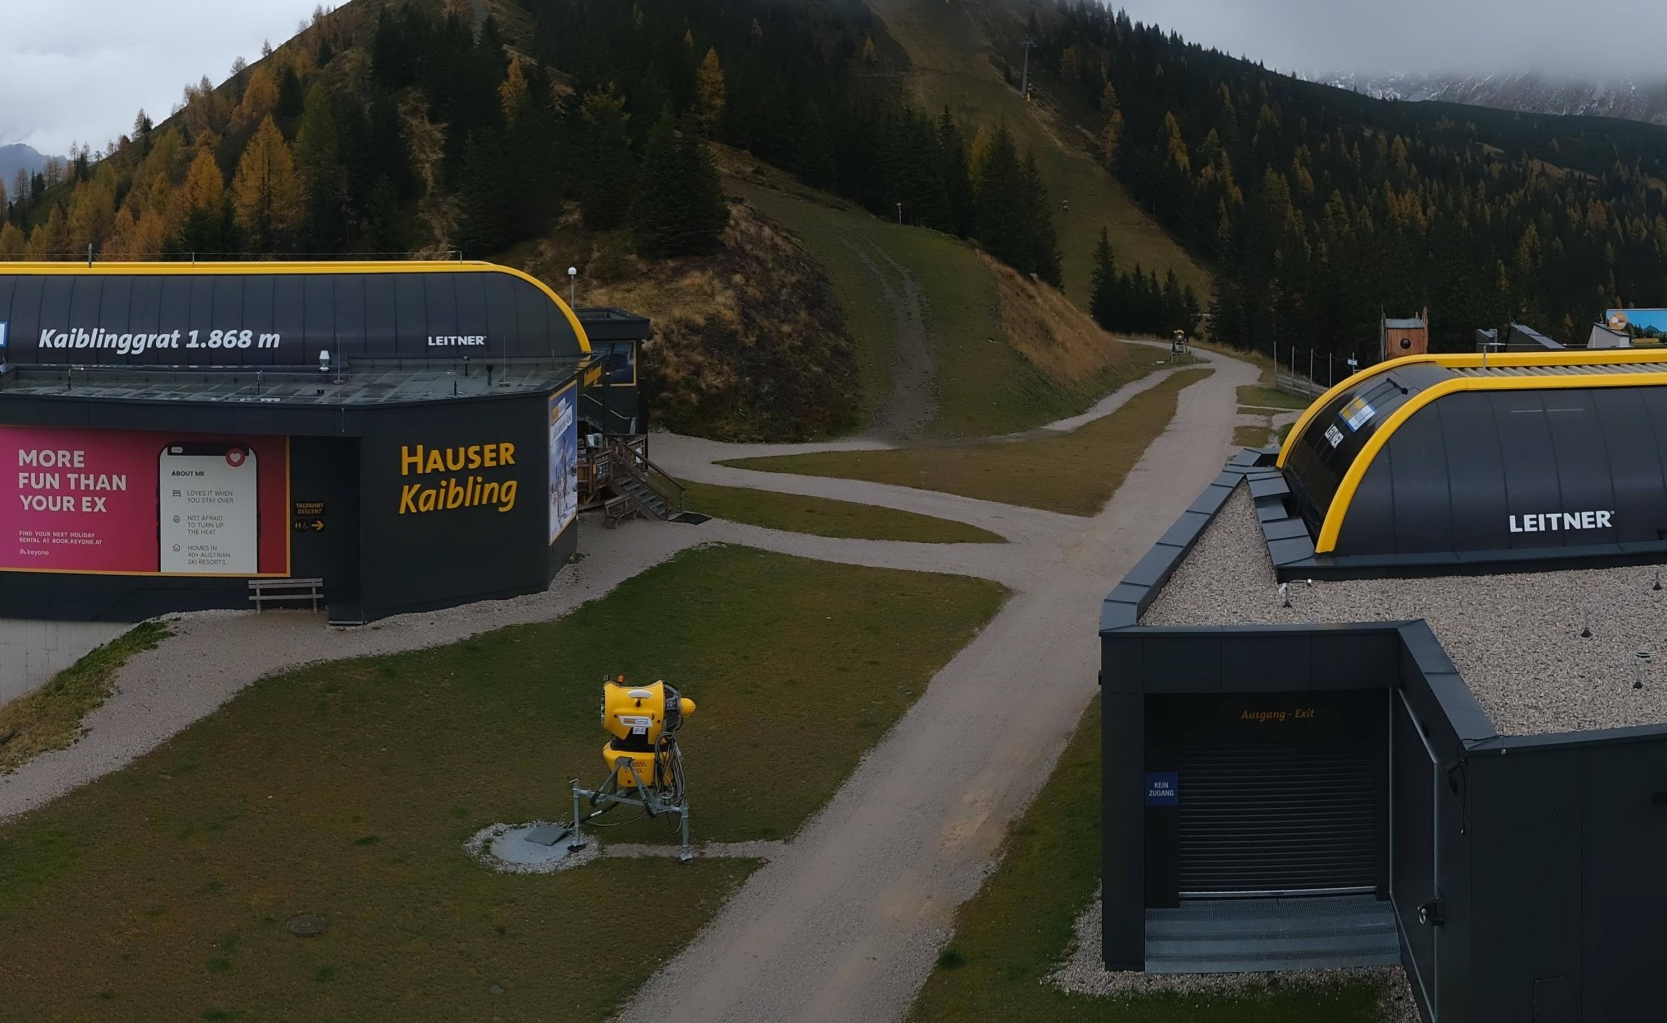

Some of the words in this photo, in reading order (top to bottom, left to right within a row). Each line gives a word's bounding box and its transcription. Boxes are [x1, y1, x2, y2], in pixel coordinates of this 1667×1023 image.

[38, 328, 181, 355] Kaiblinggrat
[186, 329, 252, 348] 1.868
[258, 333, 280, 348] m
[427, 335, 485, 346] LEITNER
[18, 449, 85, 468] MORE
[401, 442, 516, 476] HAUSER
[18, 472, 60, 490] FUN
[67, 474, 127, 491] THAN
[20, 495, 76, 512] YOUR
[82, 497, 107, 512] EX
[399, 476, 518, 514] Kaibling
[1509, 510, 1613, 533] LEITNER
[27, 548, 49, 556] keyone
[1240, 709, 1286, 722] Ausgang
[1295, 708, 1315, 719] Exit
[1148, 789, 1174, 797] ZUGANG
[1154, 781, 1169, 789] KEIN
